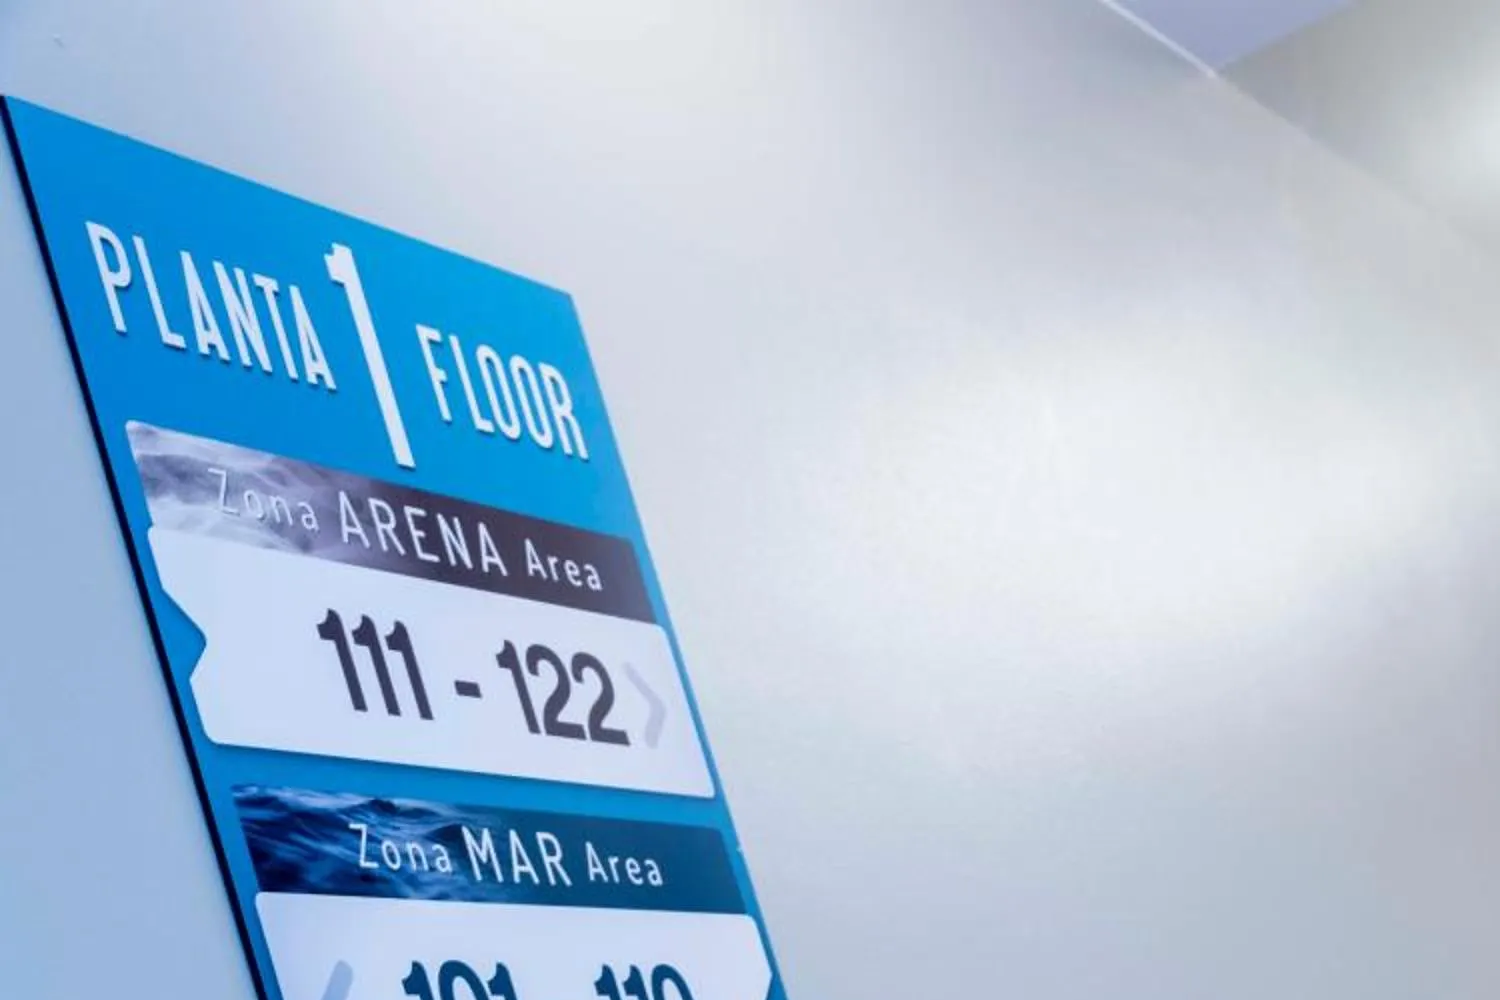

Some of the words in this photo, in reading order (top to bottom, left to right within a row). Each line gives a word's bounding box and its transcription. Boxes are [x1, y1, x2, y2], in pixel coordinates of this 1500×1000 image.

[86, 221, 336, 392] PLANTA
[324, 242, 416, 469] 1
[416, 324, 590, 461] FLOOR
[207, 468, 320, 533] Zona
[340, 491, 508, 577] ARENA
[526, 539, 603, 591] Area
[317, 608, 434, 721] 111
[454, 679, 482, 699] -
[496, 638, 631, 746] 122
[349, 823, 453, 874] Zona
[461, 825, 572, 888] MAR
[585, 841, 664, 887] Area
